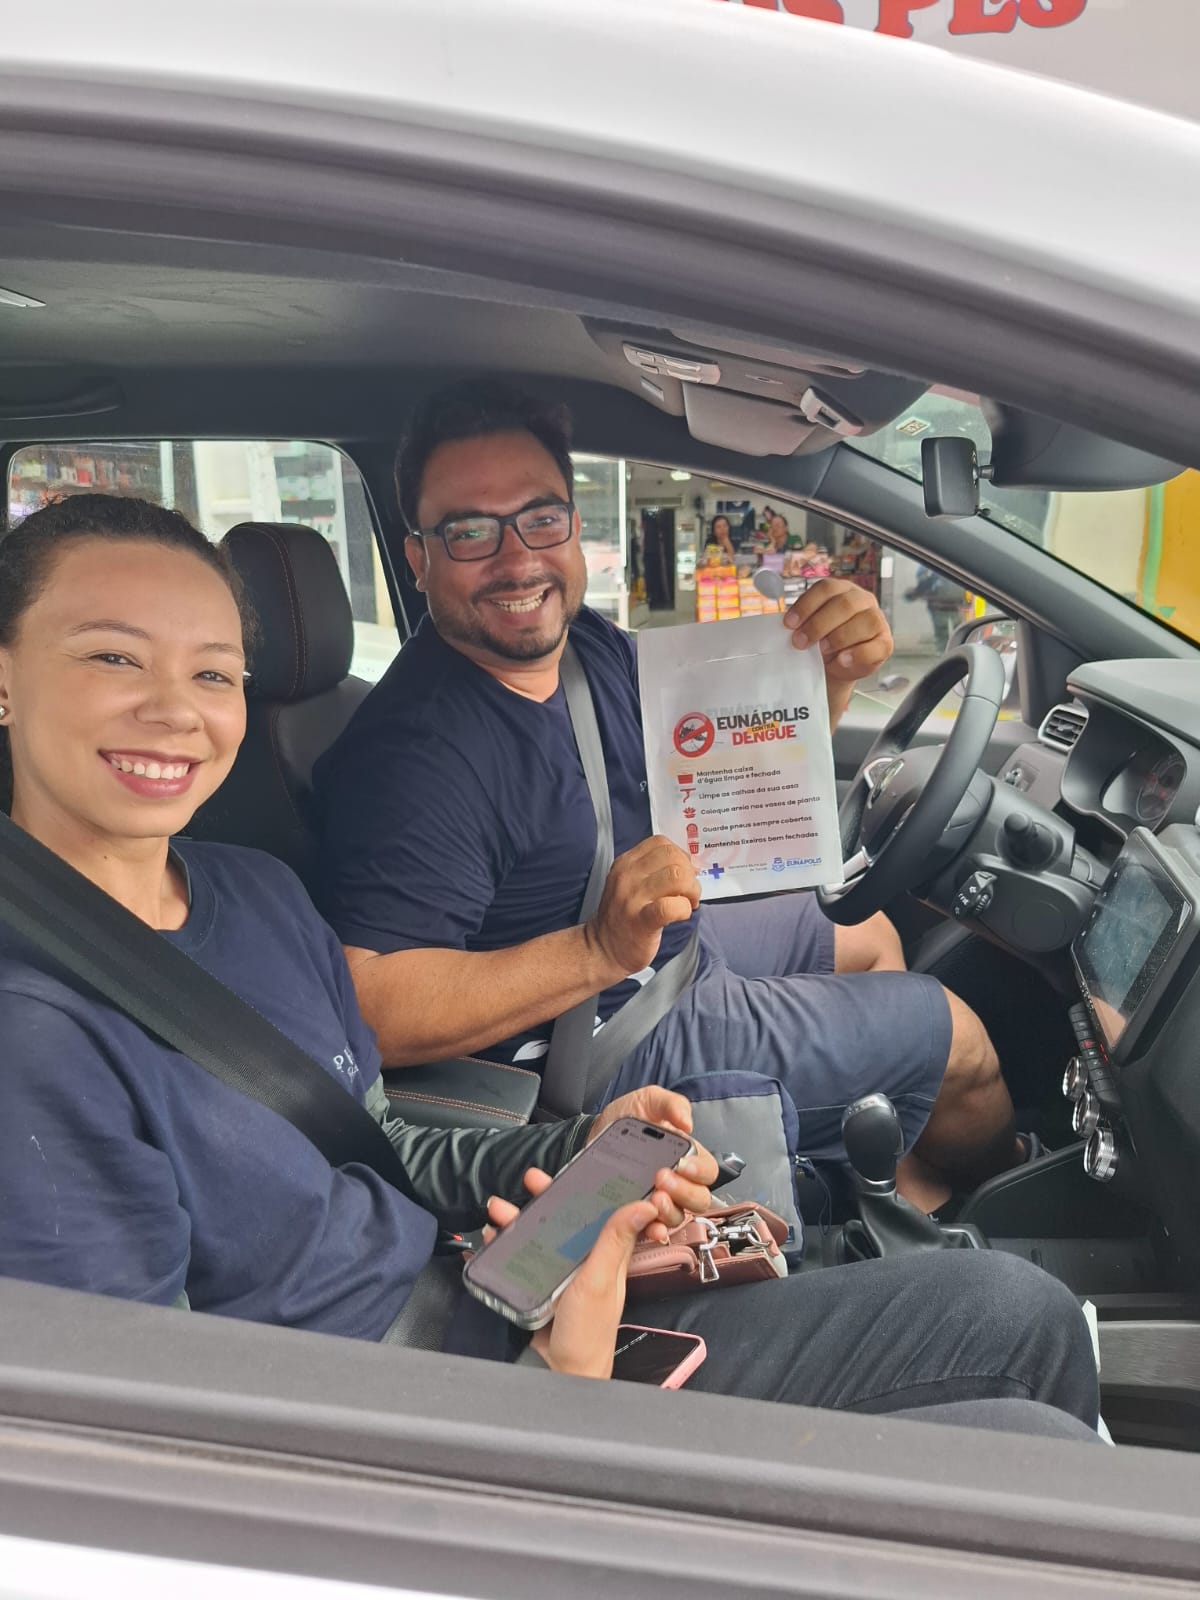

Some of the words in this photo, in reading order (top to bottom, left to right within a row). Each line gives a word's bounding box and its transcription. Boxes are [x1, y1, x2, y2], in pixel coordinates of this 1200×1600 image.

[716, 706, 810, 730] EUNÁPOLIS
[732, 724, 797, 746] DENGUE
[696, 768, 733, 777] Mantenha
[751, 769, 781, 778] fechada
[731, 788, 756, 796] calhas
[702, 824, 729, 833] Guarde
[729, 822, 752, 831] pneus
[752, 818, 780, 827] sempre
[780, 815, 813, 824] cobertos
[704, 840, 741, 849] Mantenha
[741, 837, 767, 845] lixeiras
[767, 834, 785, 842] bem
[785, 831, 819, 840] fechadas
